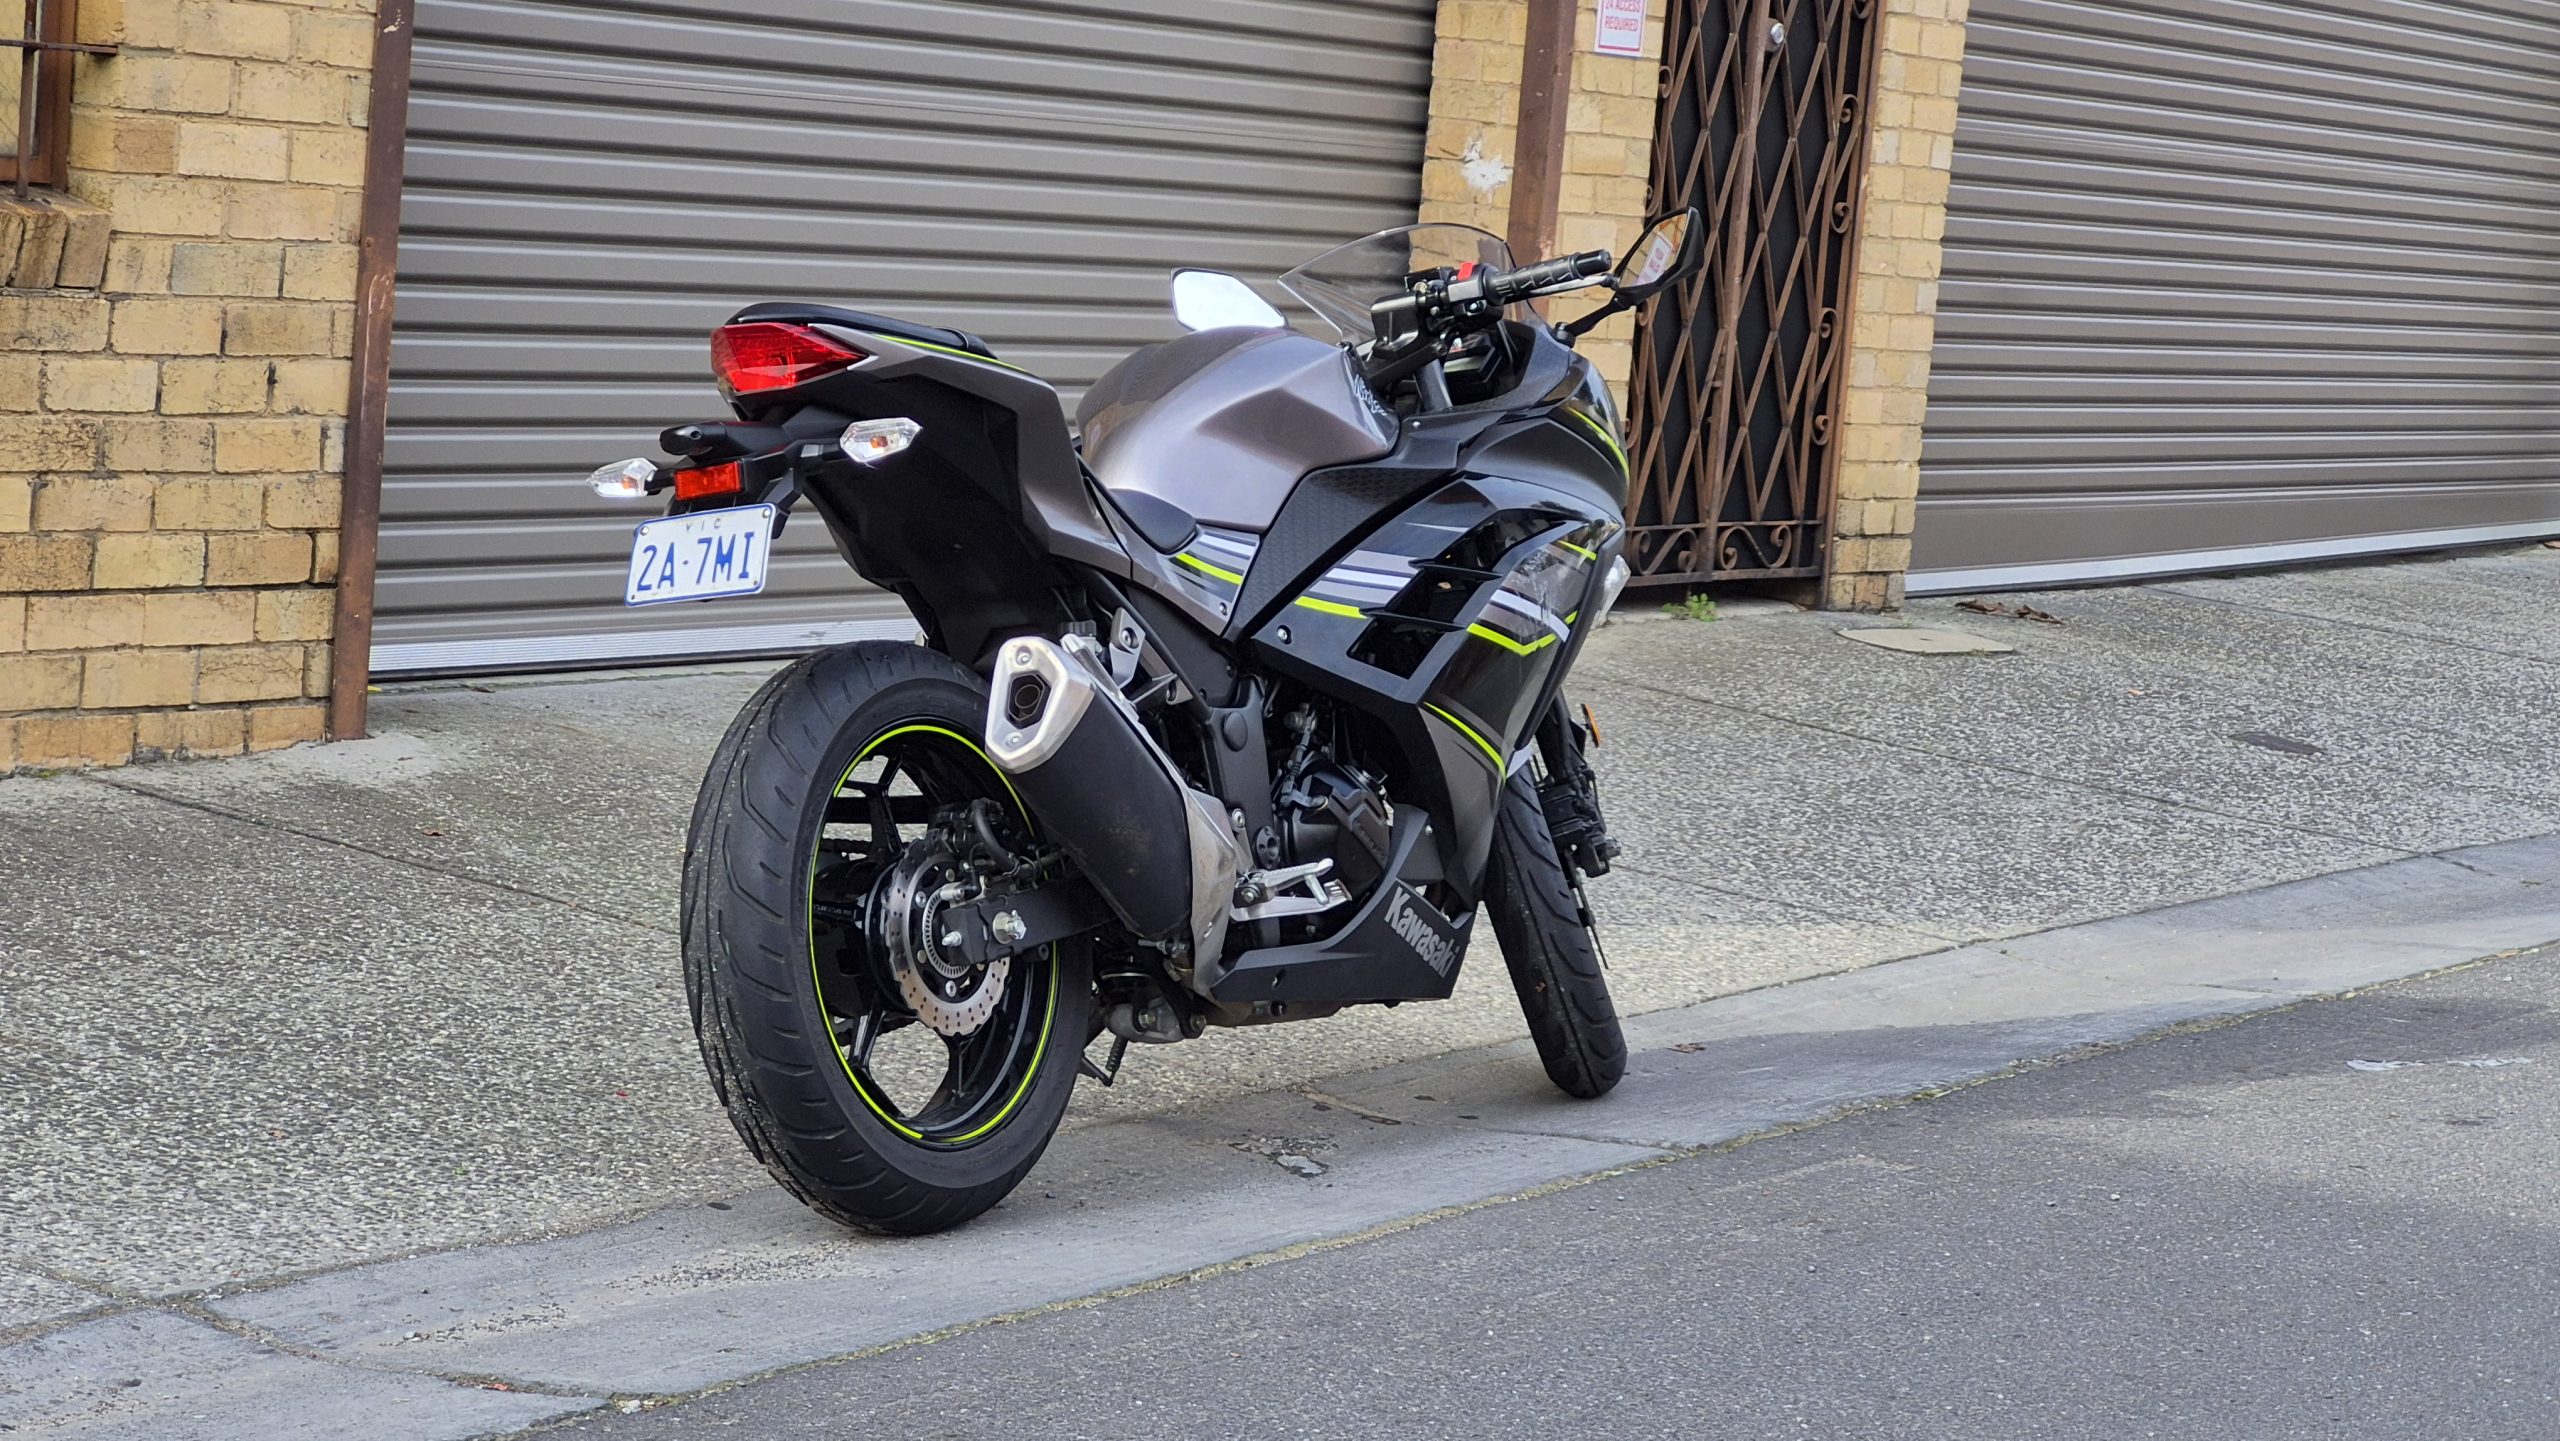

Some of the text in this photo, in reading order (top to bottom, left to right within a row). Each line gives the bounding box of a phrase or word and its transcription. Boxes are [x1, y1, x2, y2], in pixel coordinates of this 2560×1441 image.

[1605, 15, 1639, 32] REQUIRED
[686, 518, 721, 532] VIC
[1384, 886, 1460, 978] Kawasaki
